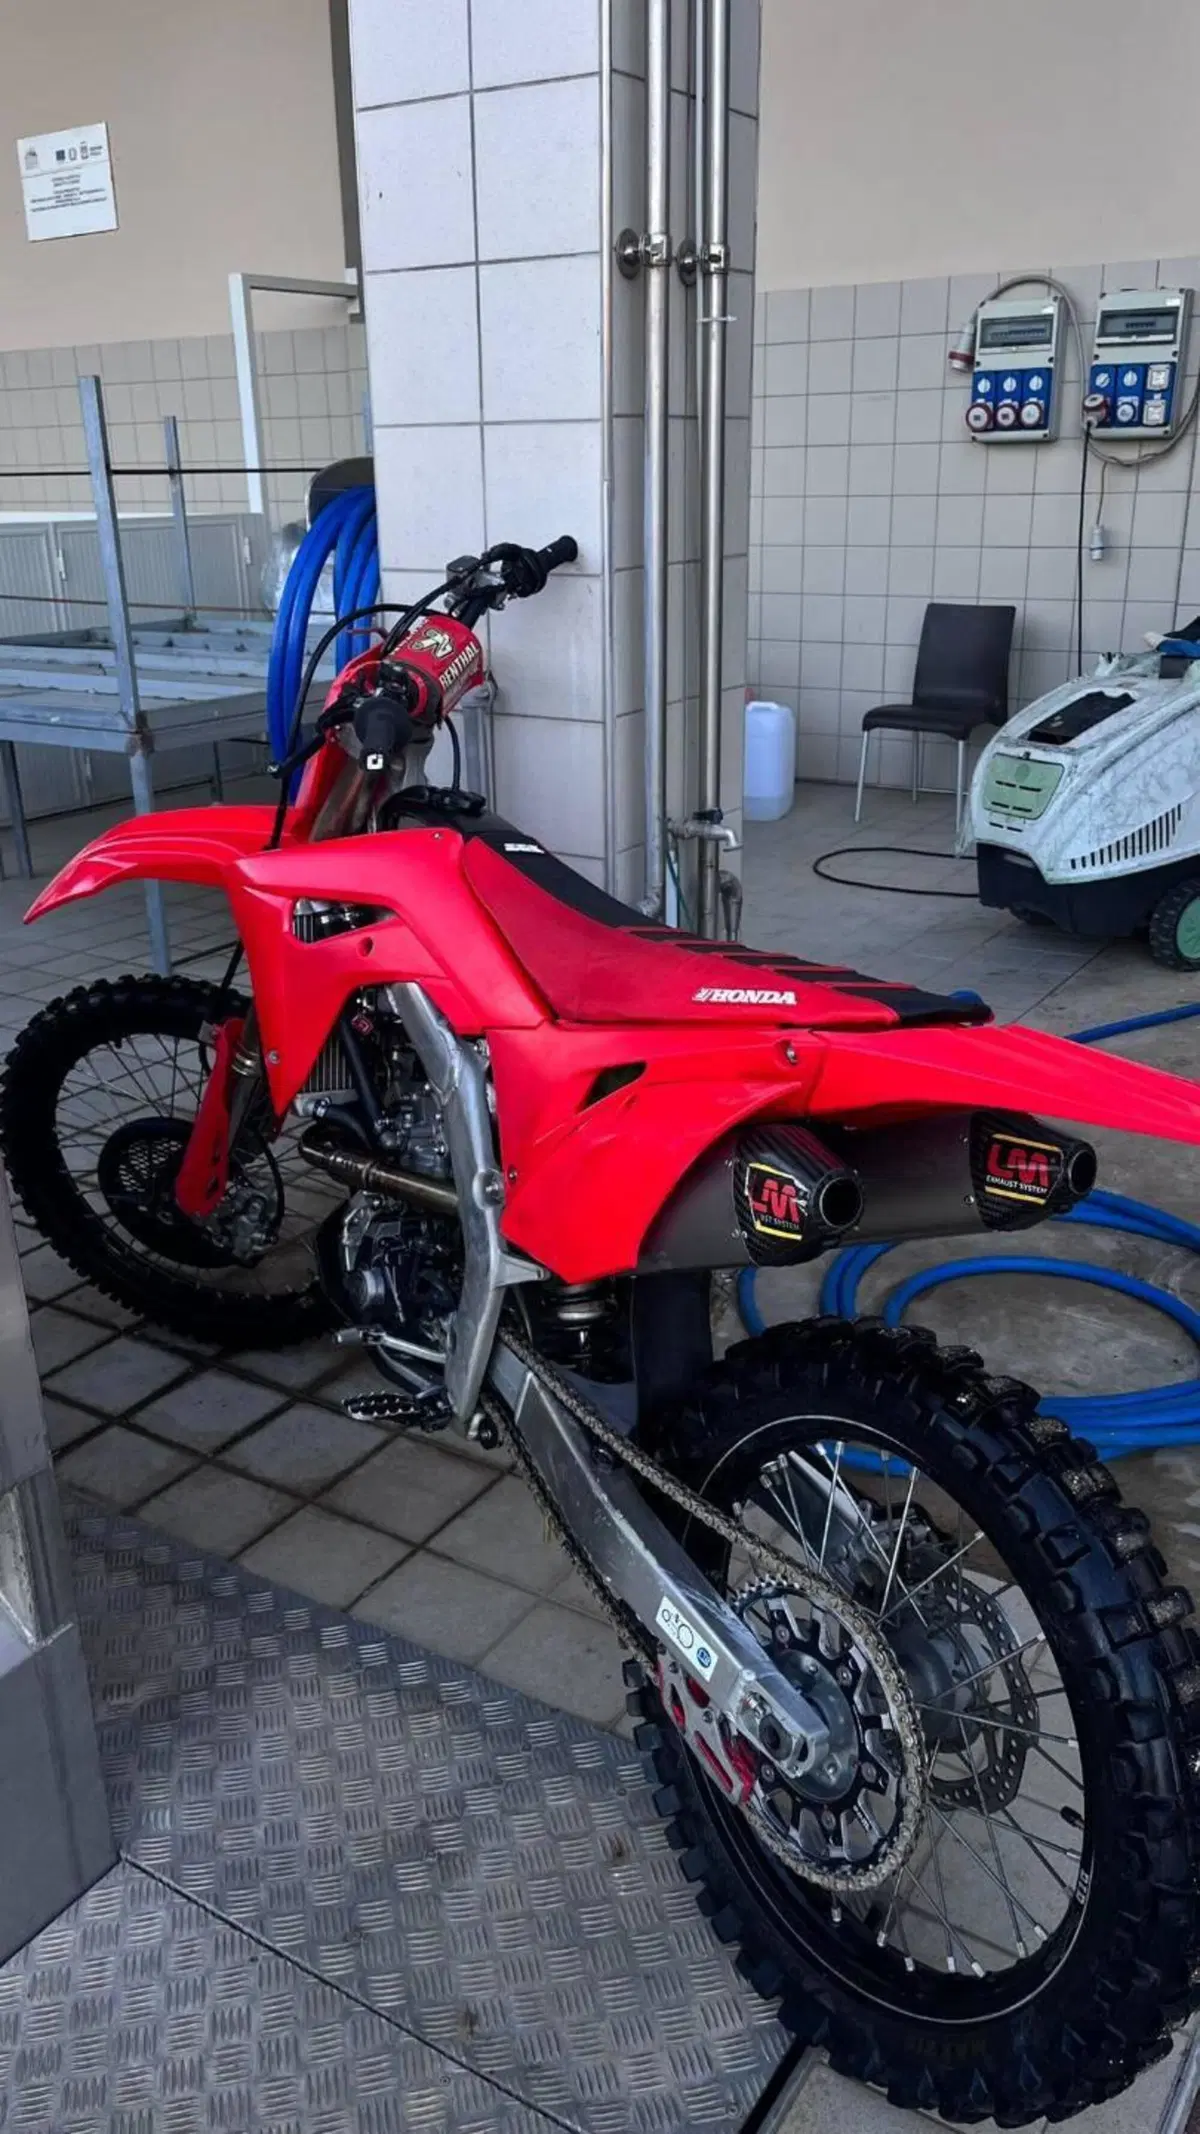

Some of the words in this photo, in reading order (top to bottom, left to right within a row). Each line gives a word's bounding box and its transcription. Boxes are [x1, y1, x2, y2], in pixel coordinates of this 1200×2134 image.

[438, 641, 479, 691] RENTHAL
[709, 988, 797, 1006] HONDA
[986, 1174, 1018, 1189] EXHAUST
[1019, 1182, 1048, 1194] SYSTEM
